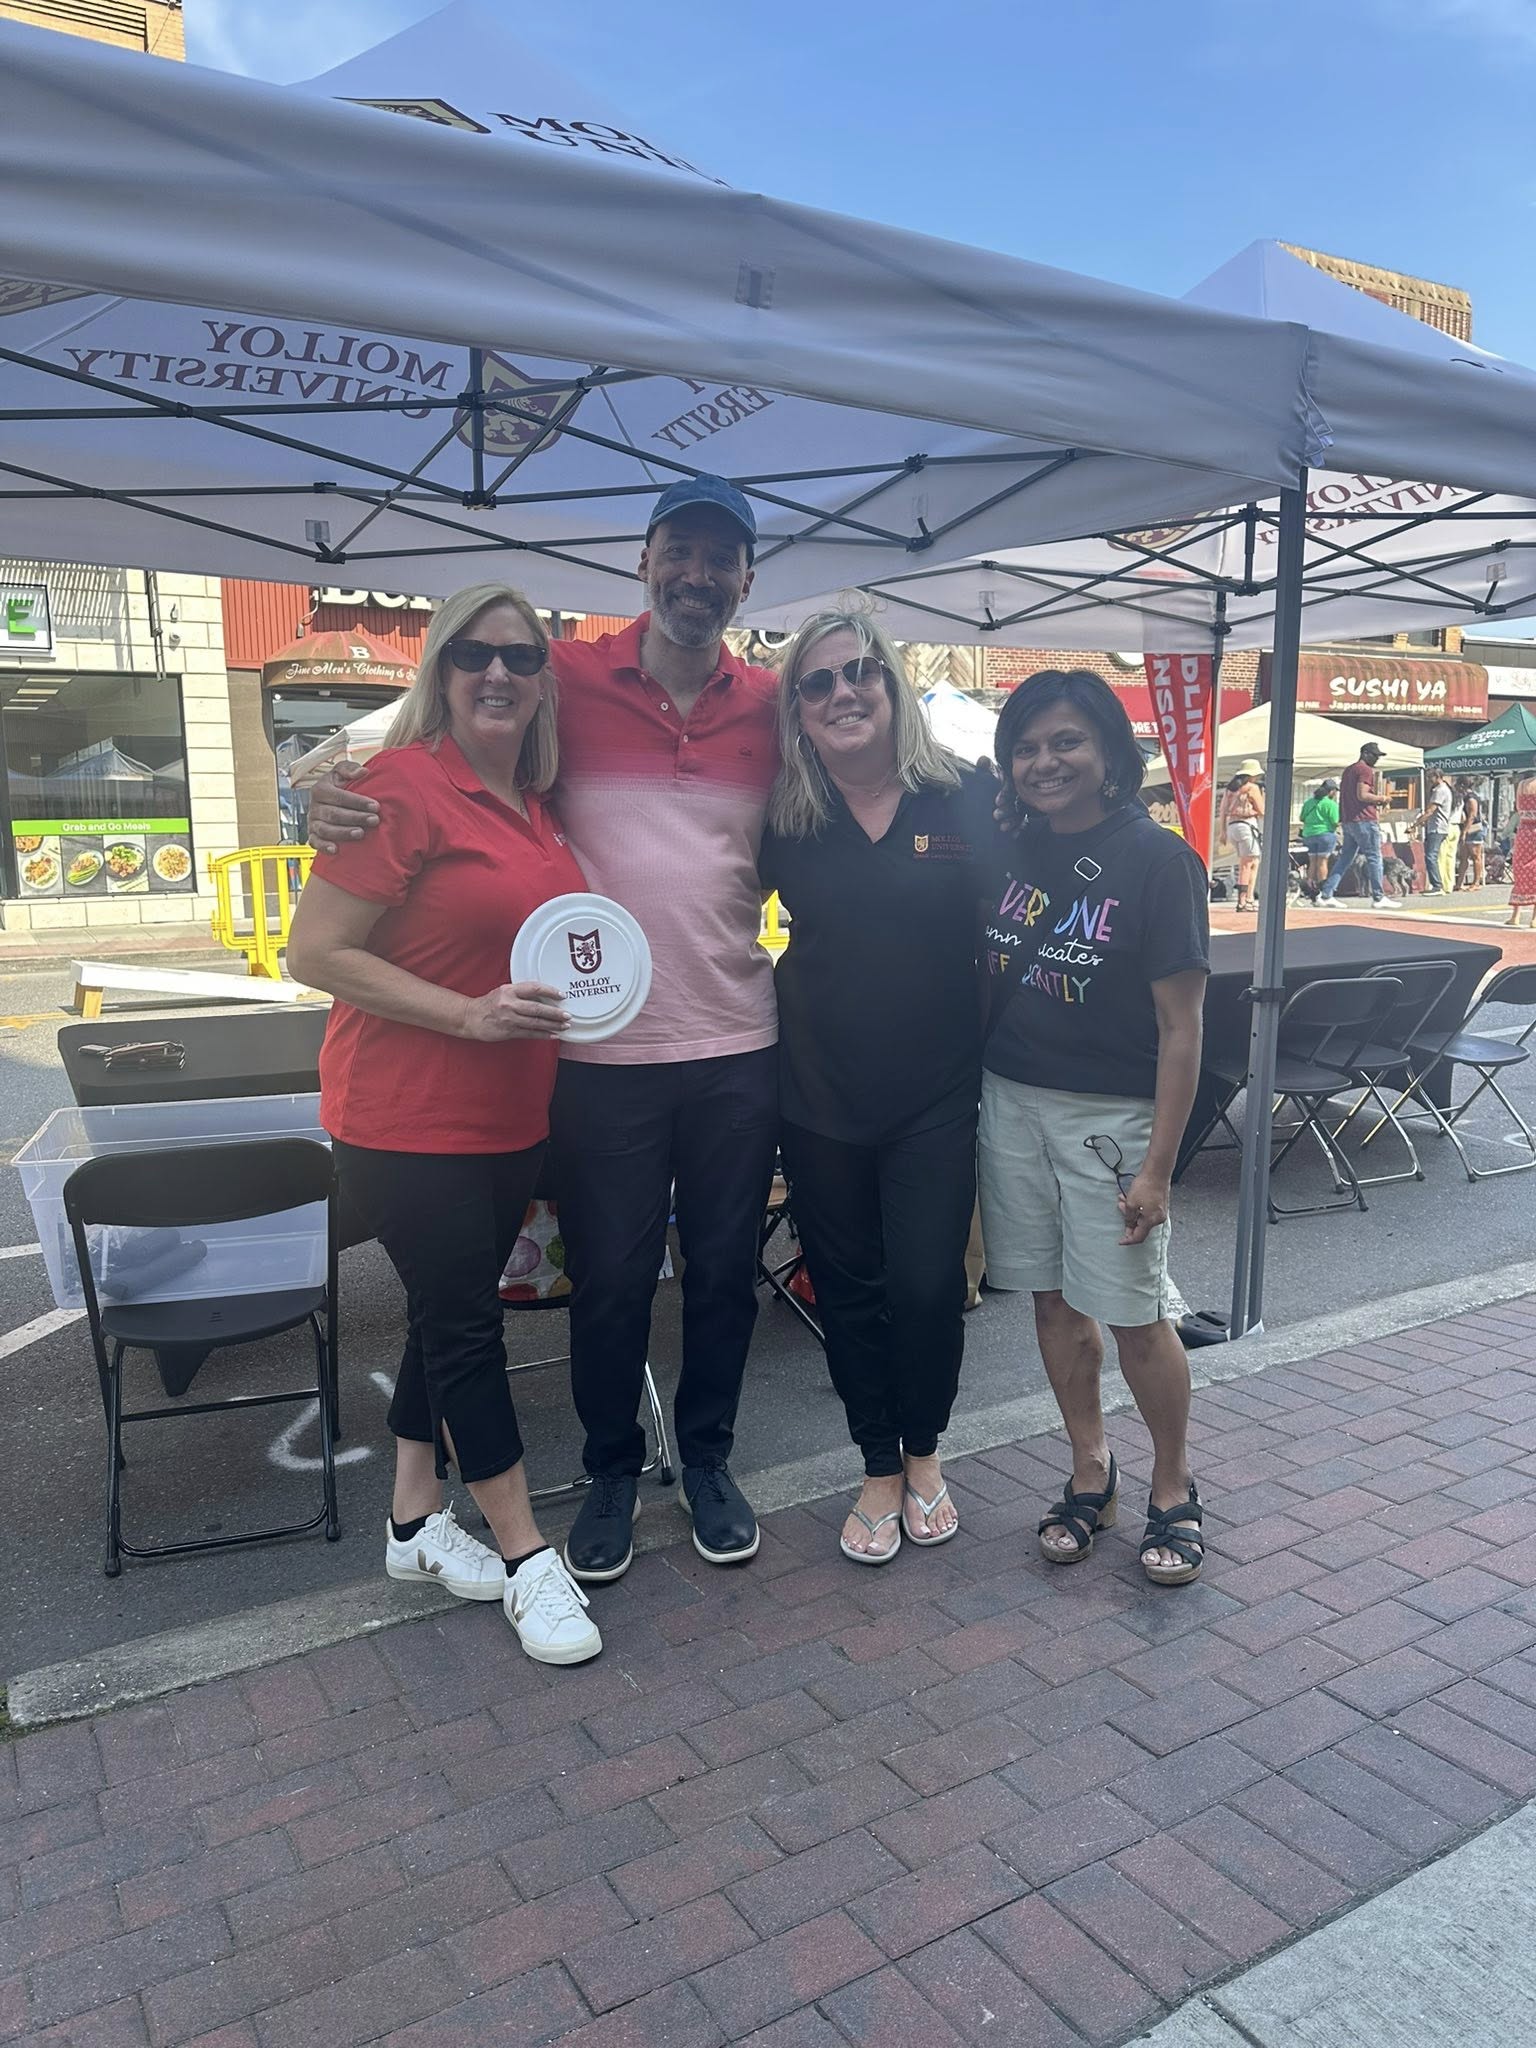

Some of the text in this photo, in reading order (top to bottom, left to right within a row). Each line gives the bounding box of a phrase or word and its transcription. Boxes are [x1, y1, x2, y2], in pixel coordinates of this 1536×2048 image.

[349, 646, 370, 659] B
[312, 662, 350, 675] Men's
[353, 662, 395, 680] Clothing
[1329, 676, 1448, 701] SUSHI YA
[1328, 700, 1384, 712] Japanese
[1386, 702, 1445, 713] Restaurant
[1180, 653, 1205, 777] DLINE
[62, 822, 151, 832] Grab and Go Meals
[569, 977, 610, 989] MOLLOY
